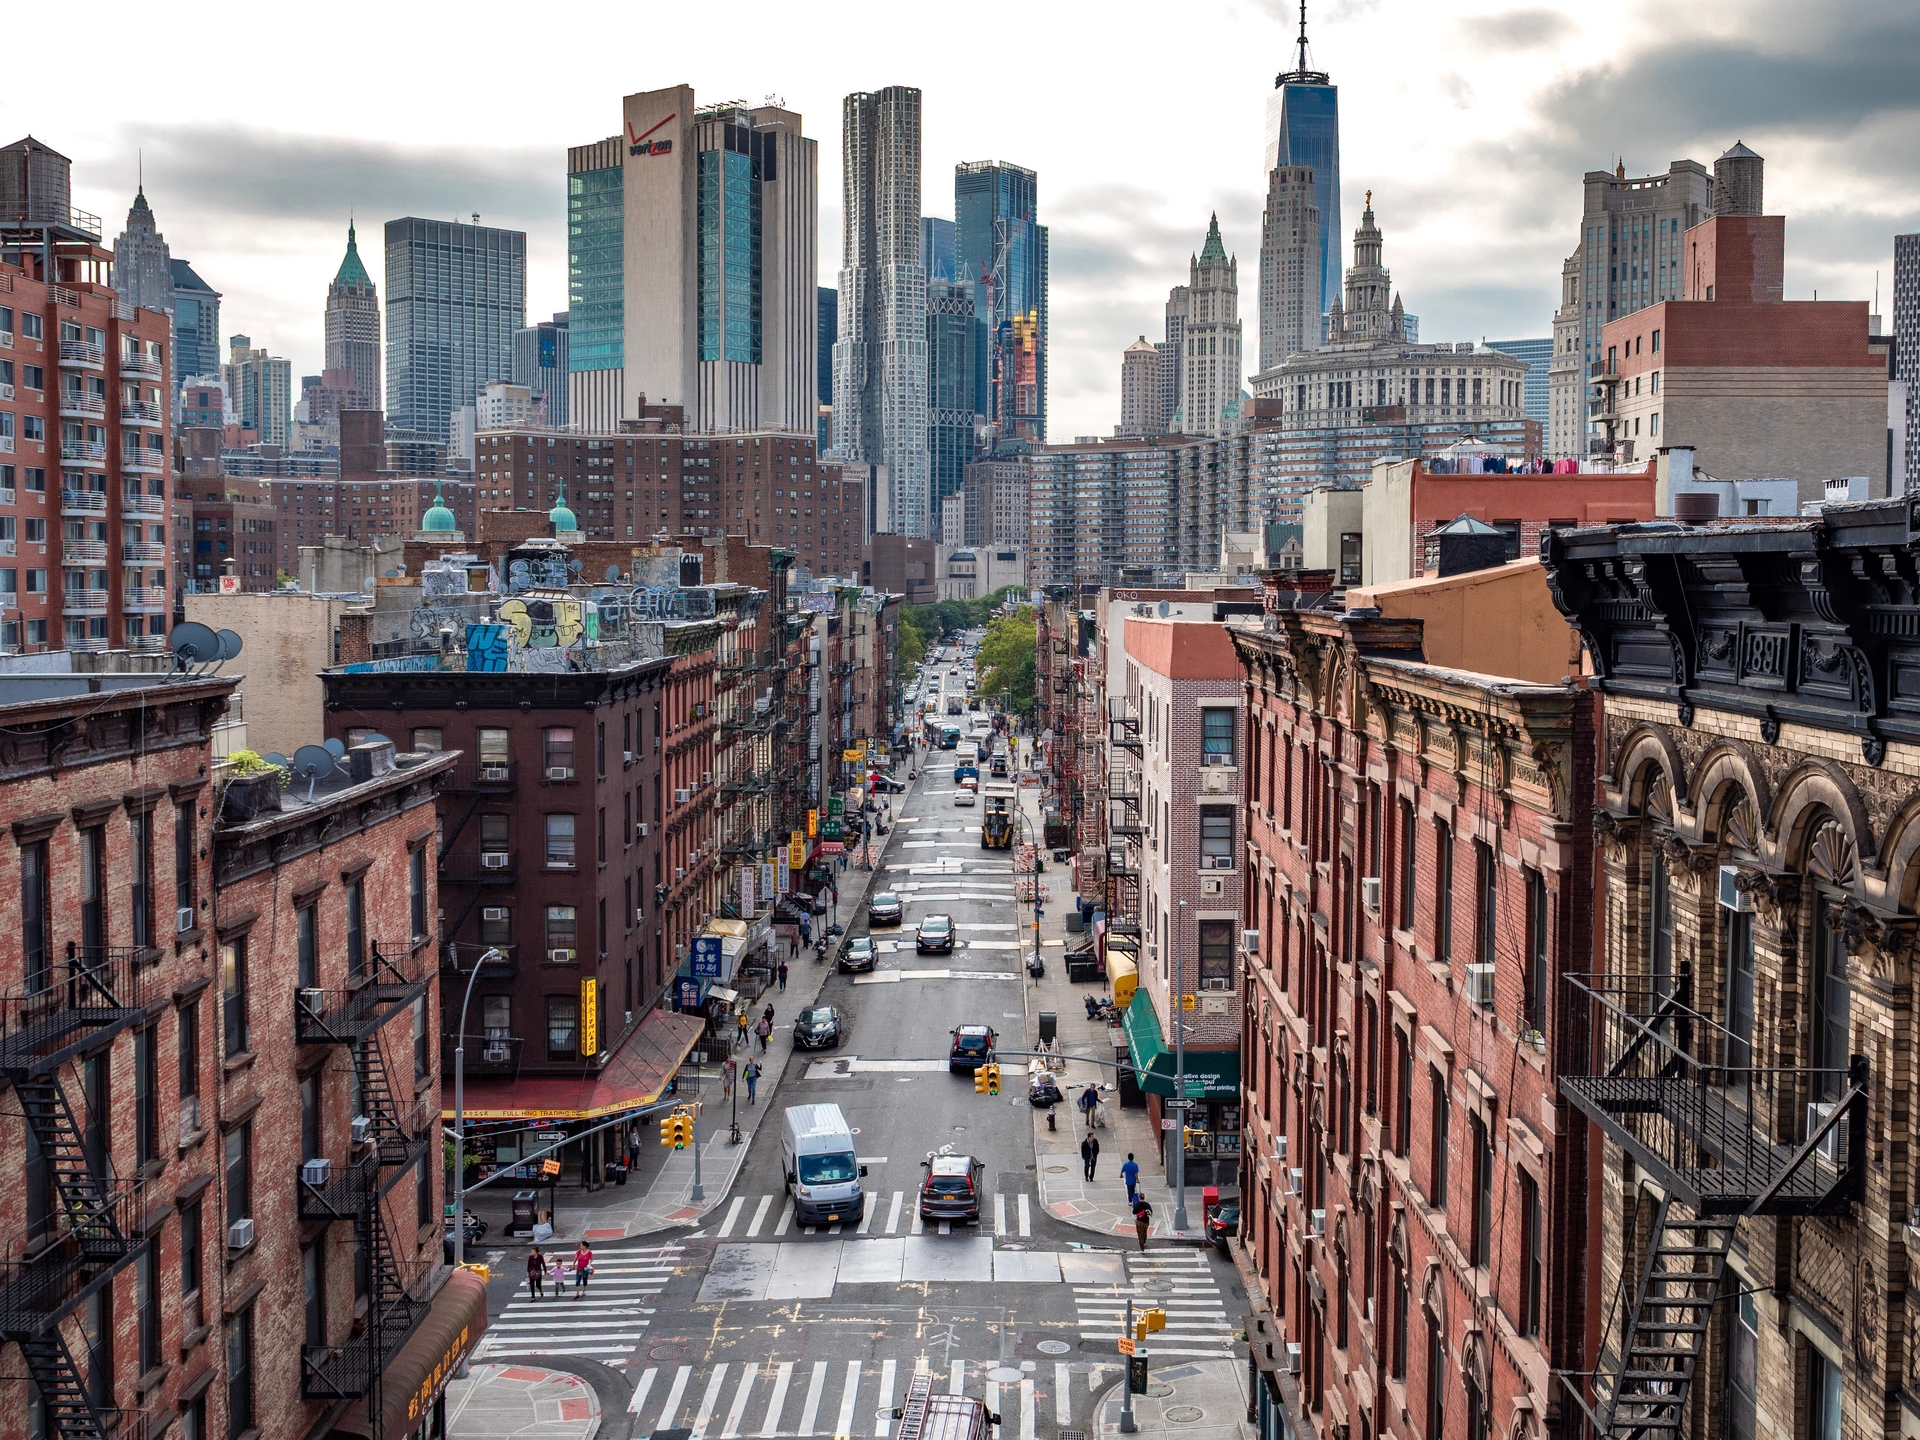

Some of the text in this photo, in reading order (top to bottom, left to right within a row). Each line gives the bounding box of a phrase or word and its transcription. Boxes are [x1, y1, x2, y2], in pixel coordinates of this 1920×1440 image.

[630, 139, 672, 157] verizon
[1120, 1339, 1133, 1348] RAISE
[1120, 1344, 1134, 1352] PLOW
[421, 1348, 467, 1416] C & S PRINTING
